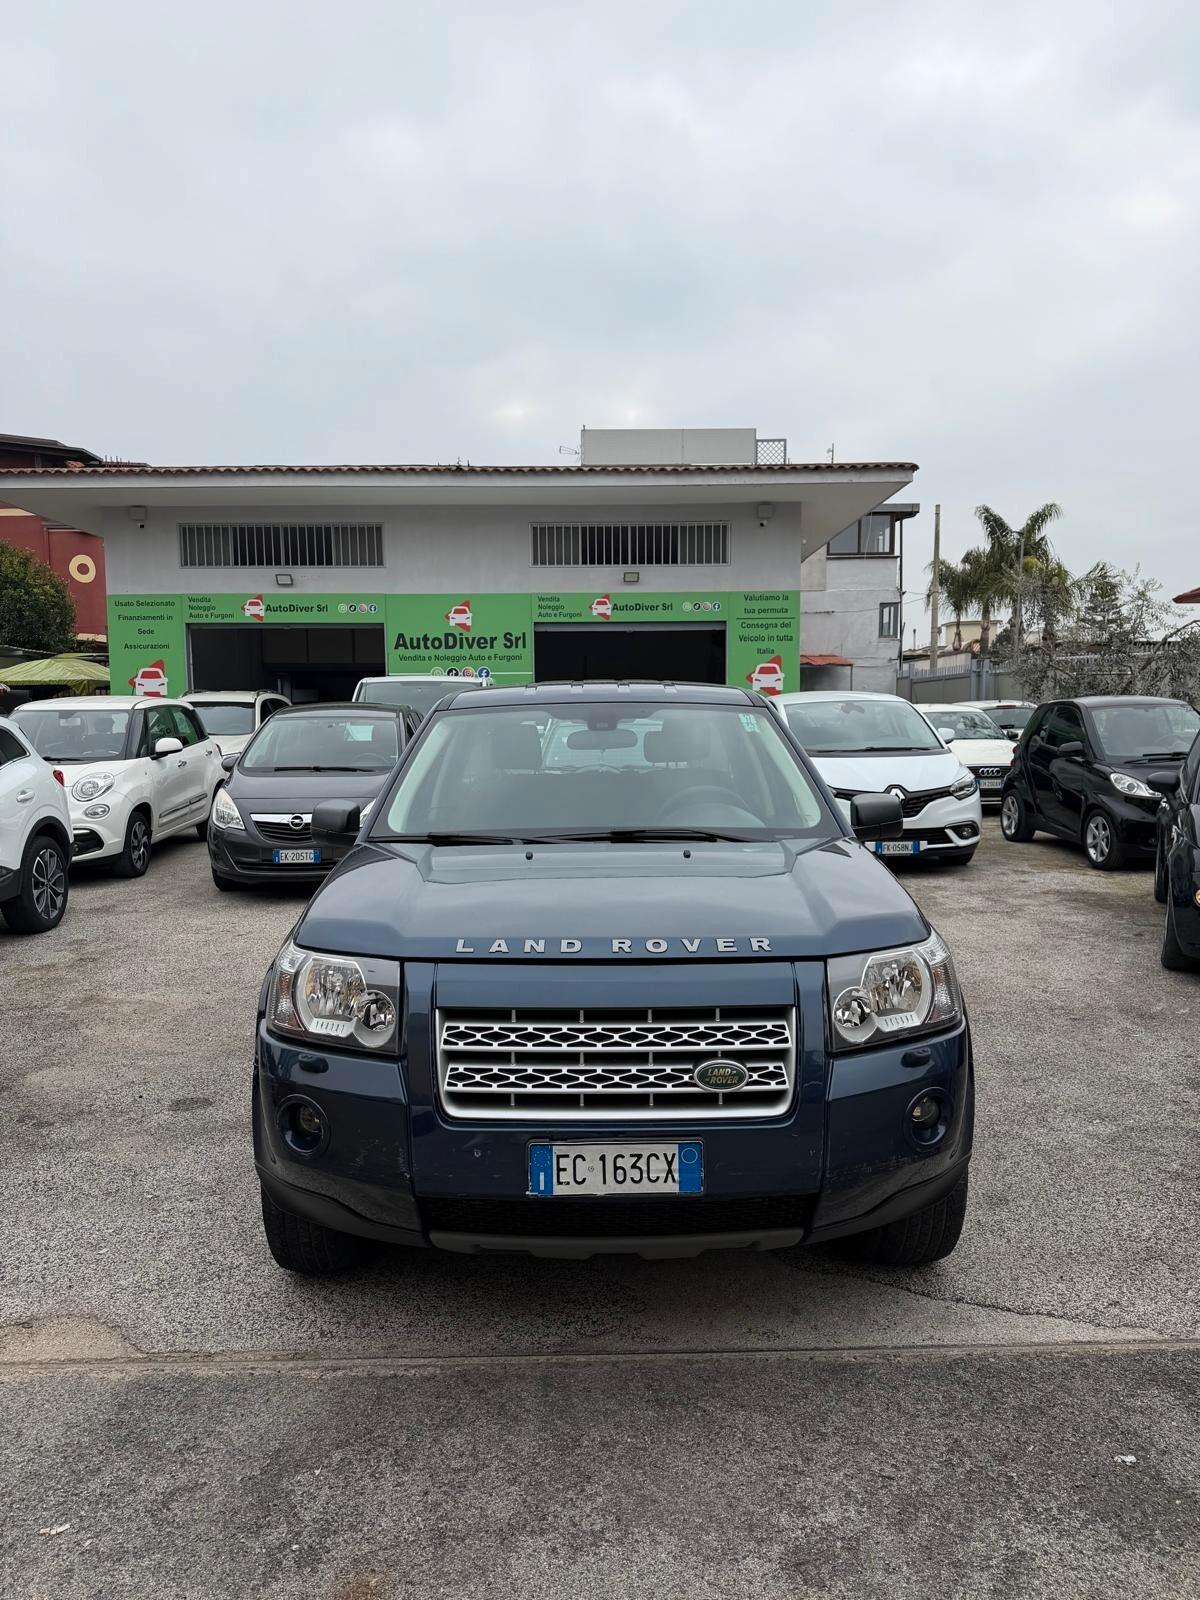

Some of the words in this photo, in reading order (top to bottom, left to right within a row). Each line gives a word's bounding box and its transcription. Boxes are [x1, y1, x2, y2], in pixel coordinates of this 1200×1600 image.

[265, 604, 314, 613] AutoDiver
[316, 604, 328, 612] Srl
[612, 603, 659, 612] AutoDiver
[662, 603, 673, 611] Srl
[758, 607, 788, 615] permuta
[741, 621, 778, 630] Consegna
[394, 632, 497, 650] AutoDiver
[503, 631, 527, 649] Srl
[738, 634, 766, 642] Veicolo
[124, 642, 170, 650] Assicurazioni
[399, 653, 426, 661] Vendita
[434, 654, 467, 663] Noleggio
[494, 653, 523, 662] Furgoni
[455, 938, 583, 954] LAND
[612, 937, 773, 953] ROVER
[555, 1153, 587, 1186] EC
[598, 1152, 677, 1185] 163CX
